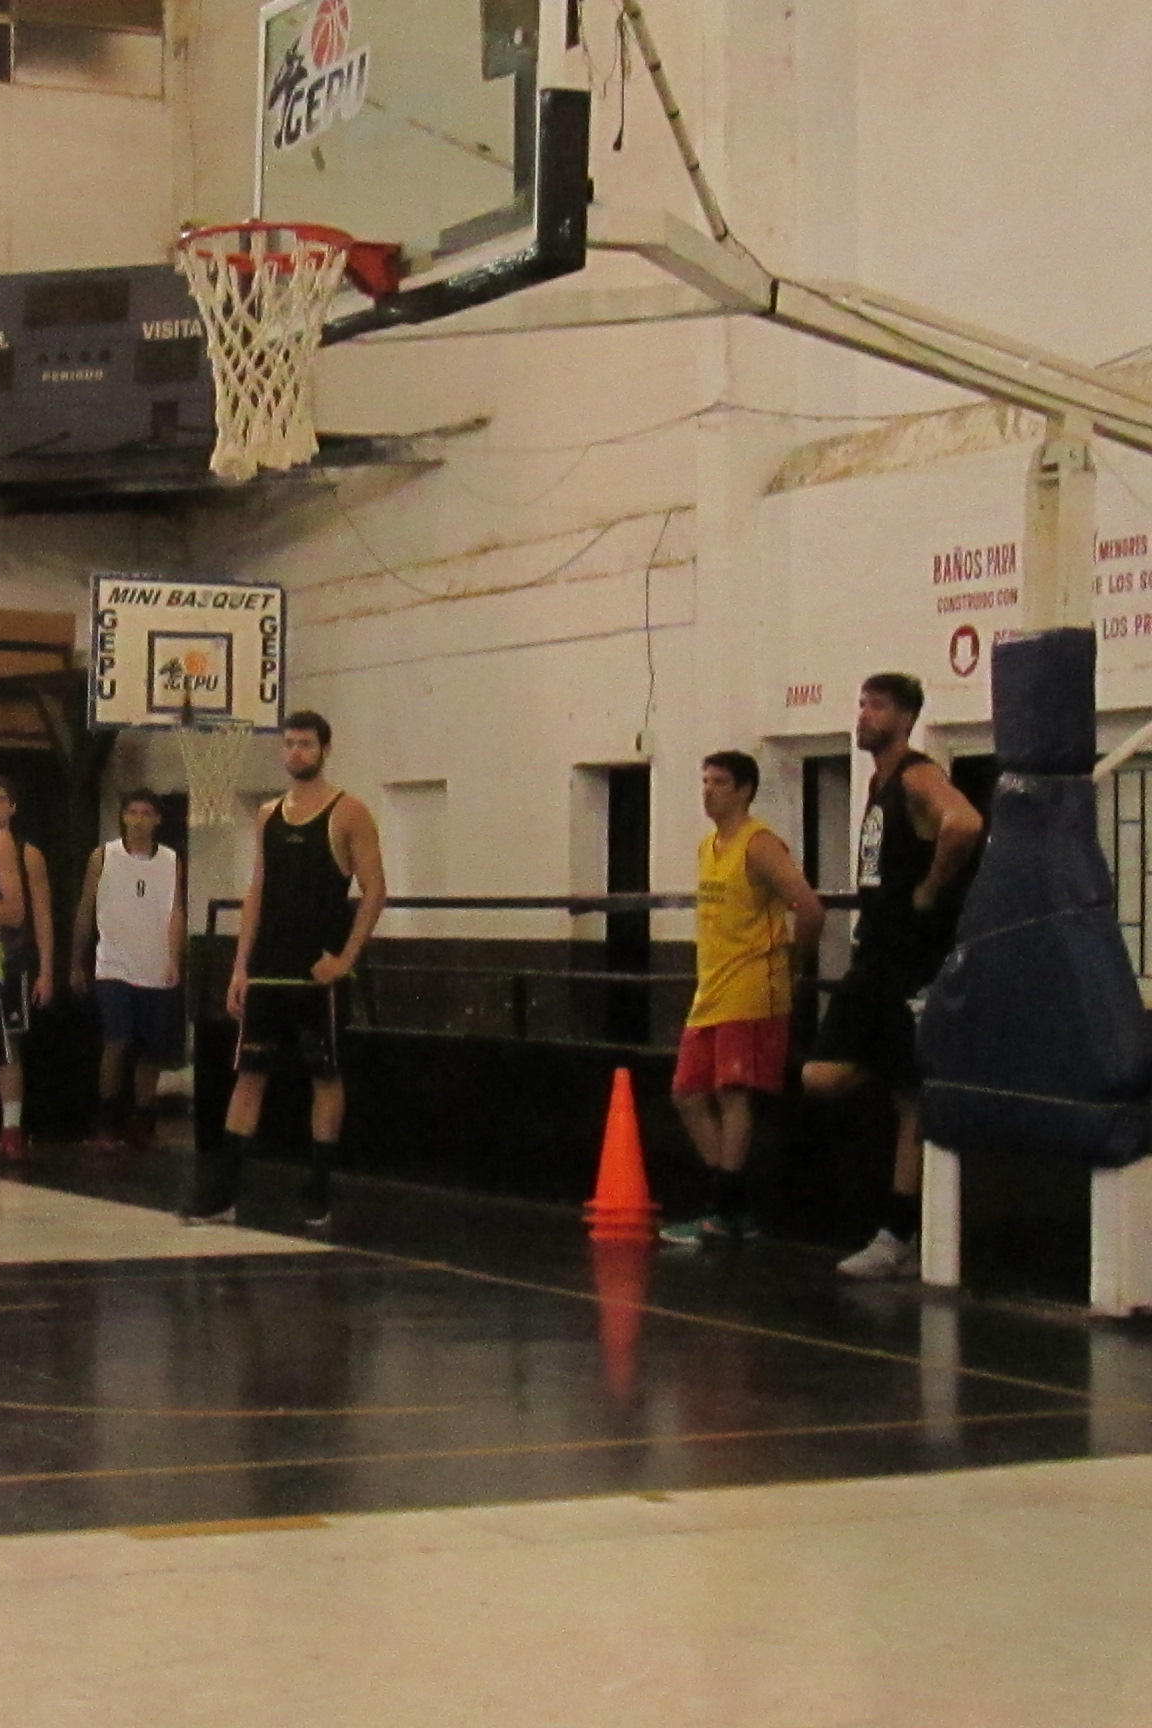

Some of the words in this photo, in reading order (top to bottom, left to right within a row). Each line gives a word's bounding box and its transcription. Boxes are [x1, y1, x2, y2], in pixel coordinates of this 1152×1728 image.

[933, 546, 982, 584] BAÑOS
[987, 543, 1016, 577] PARA
[1108, 572, 1134, 594] LOS
[108, 586, 162, 605] MINI
[166, 589, 276, 611] BASQUET
[1102, 614, 1128, 640] LOS
[98, 608, 118, 701] GEPU
[259, 614, 278, 704] GEPU
[786, 684, 822, 707] DAMAS
